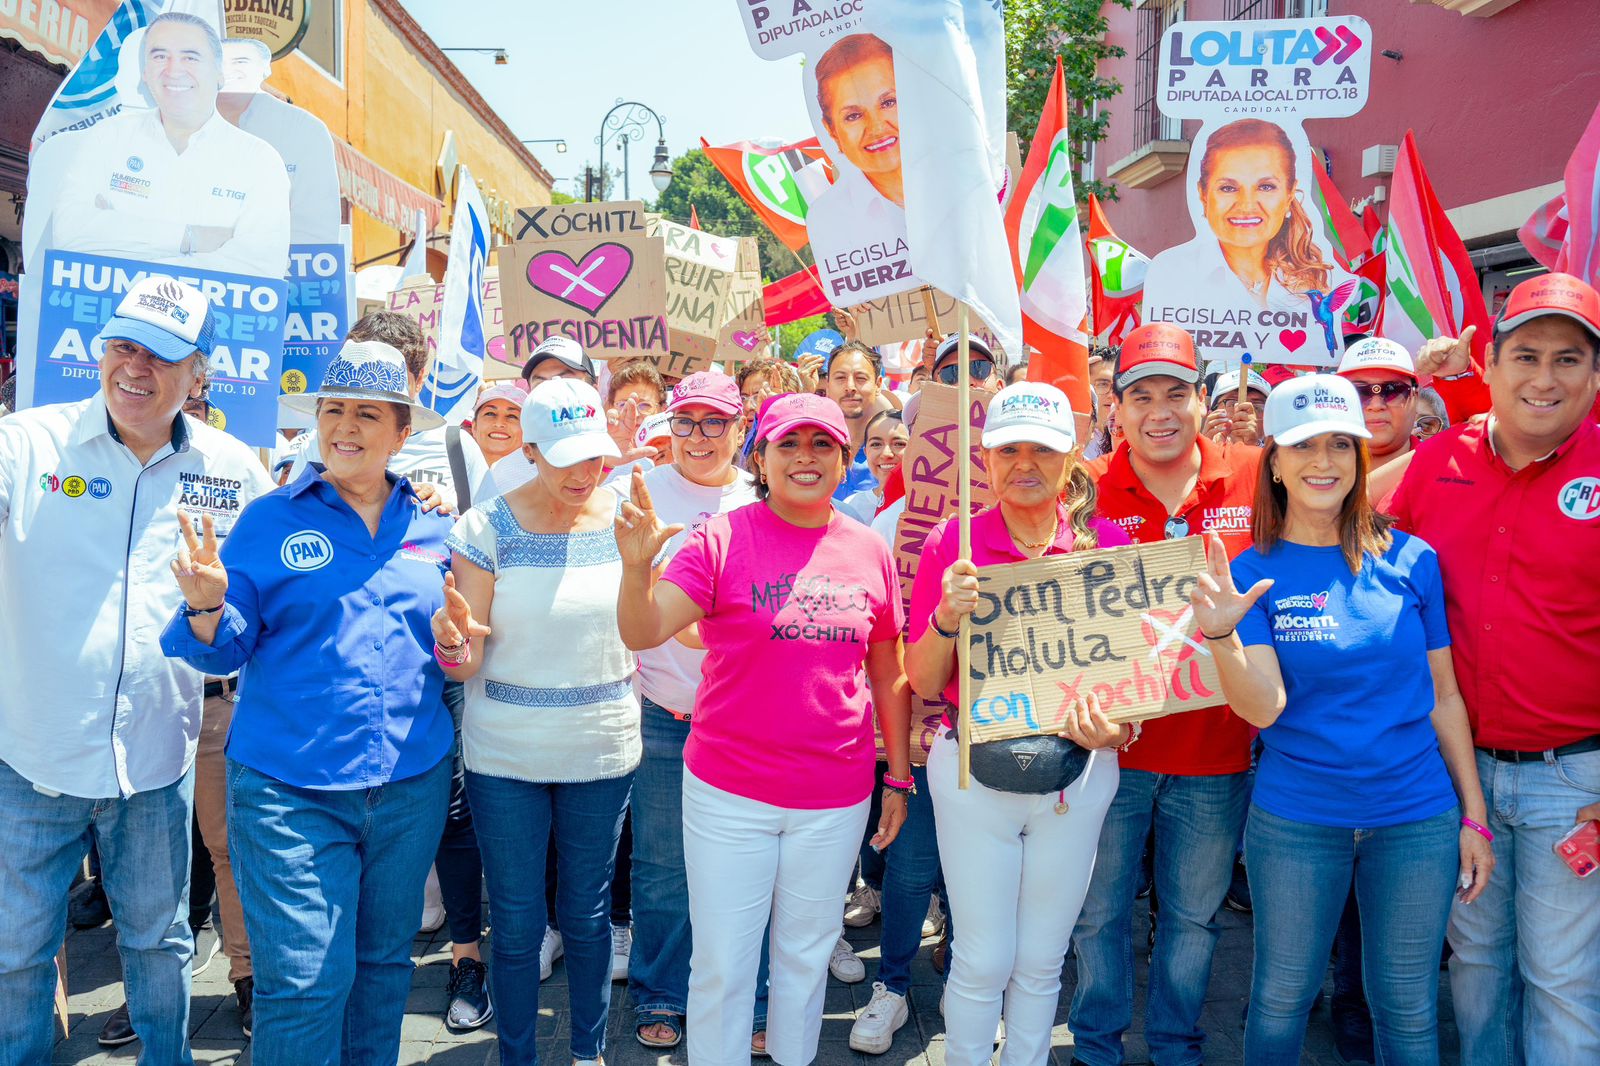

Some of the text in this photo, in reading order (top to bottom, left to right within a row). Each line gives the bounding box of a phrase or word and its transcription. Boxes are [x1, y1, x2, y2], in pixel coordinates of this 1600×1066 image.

[235, 26, 263, 35] ESPINOSA
[758, 10, 834, 45] DIPUTADA
[1169, 28, 1320, 67] LOLITA
[1168, 65, 1357, 87] PARRA
[1167, 90, 1241, 102] DIPUTADA
[1245, 89, 1293, 101] LOCAL
[516, 206, 646, 240] XÓCHITL
[824, 237, 909, 274] LEGISLA
[830, 259, 912, 297] FUERZ
[1150, 307, 1308, 328] LEGISLAR CON
[510, 315, 670, 358] PRESIDENTA
[1138, 339, 1181, 351] NÉSTOR
[1195, 329, 1271, 350] ERZA Y
[315, 346, 329, 355] 10
[241, 385, 256, 396] 10
[1314, 388, 1329, 396] UN
[1314, 396, 1346, 404] MEJOR
[1315, 403, 1348, 411] RUMBO
[92, 482, 108, 495] PAN
[179, 471, 242, 489] HUMBERTO
[183, 482, 237, 500] EL TIGRE
[1564, 485, 1600, 507] PRI
[178, 493, 240, 511] AGUILAR
[1203, 506, 1245, 519] LUPITA
[289, 540, 325, 563] PAN
[970, 554, 1200, 625] San Pedro
[769, 619, 860, 643] XÓCHITL
[1274, 613, 1340, 630] XÓCHITL
[1274, 633, 1337, 642] PRESIDENTA
[970, 626, 1126, 680] Cholula
[970, 690, 1040, 731] con
